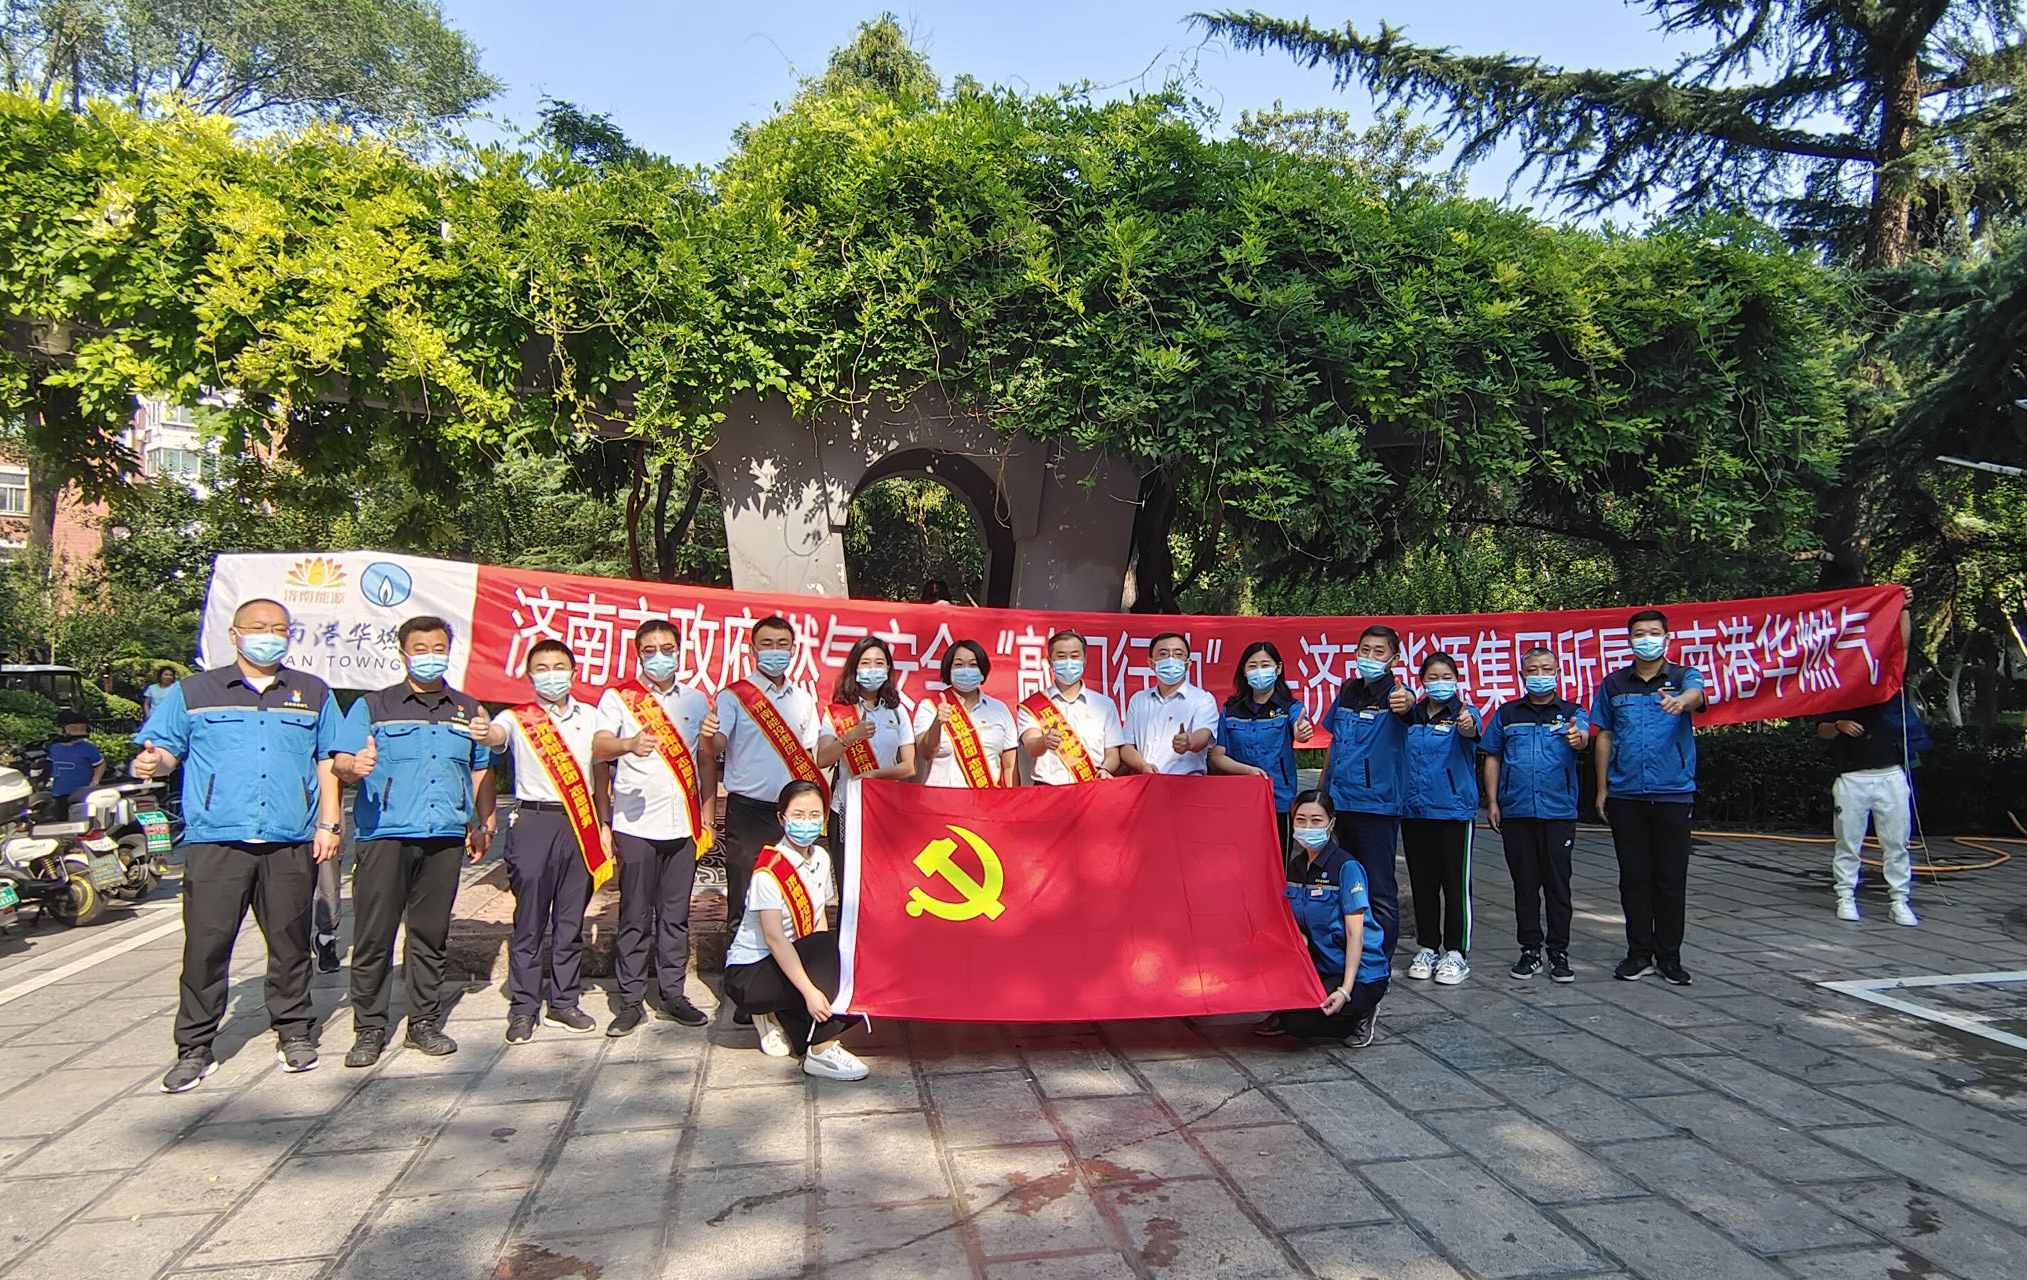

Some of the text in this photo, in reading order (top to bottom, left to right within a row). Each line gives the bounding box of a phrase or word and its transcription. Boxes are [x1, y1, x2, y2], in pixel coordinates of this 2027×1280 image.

[288, 618, 398, 650] 南港华燃
[286, 655, 401, 671] AN TOWNG
